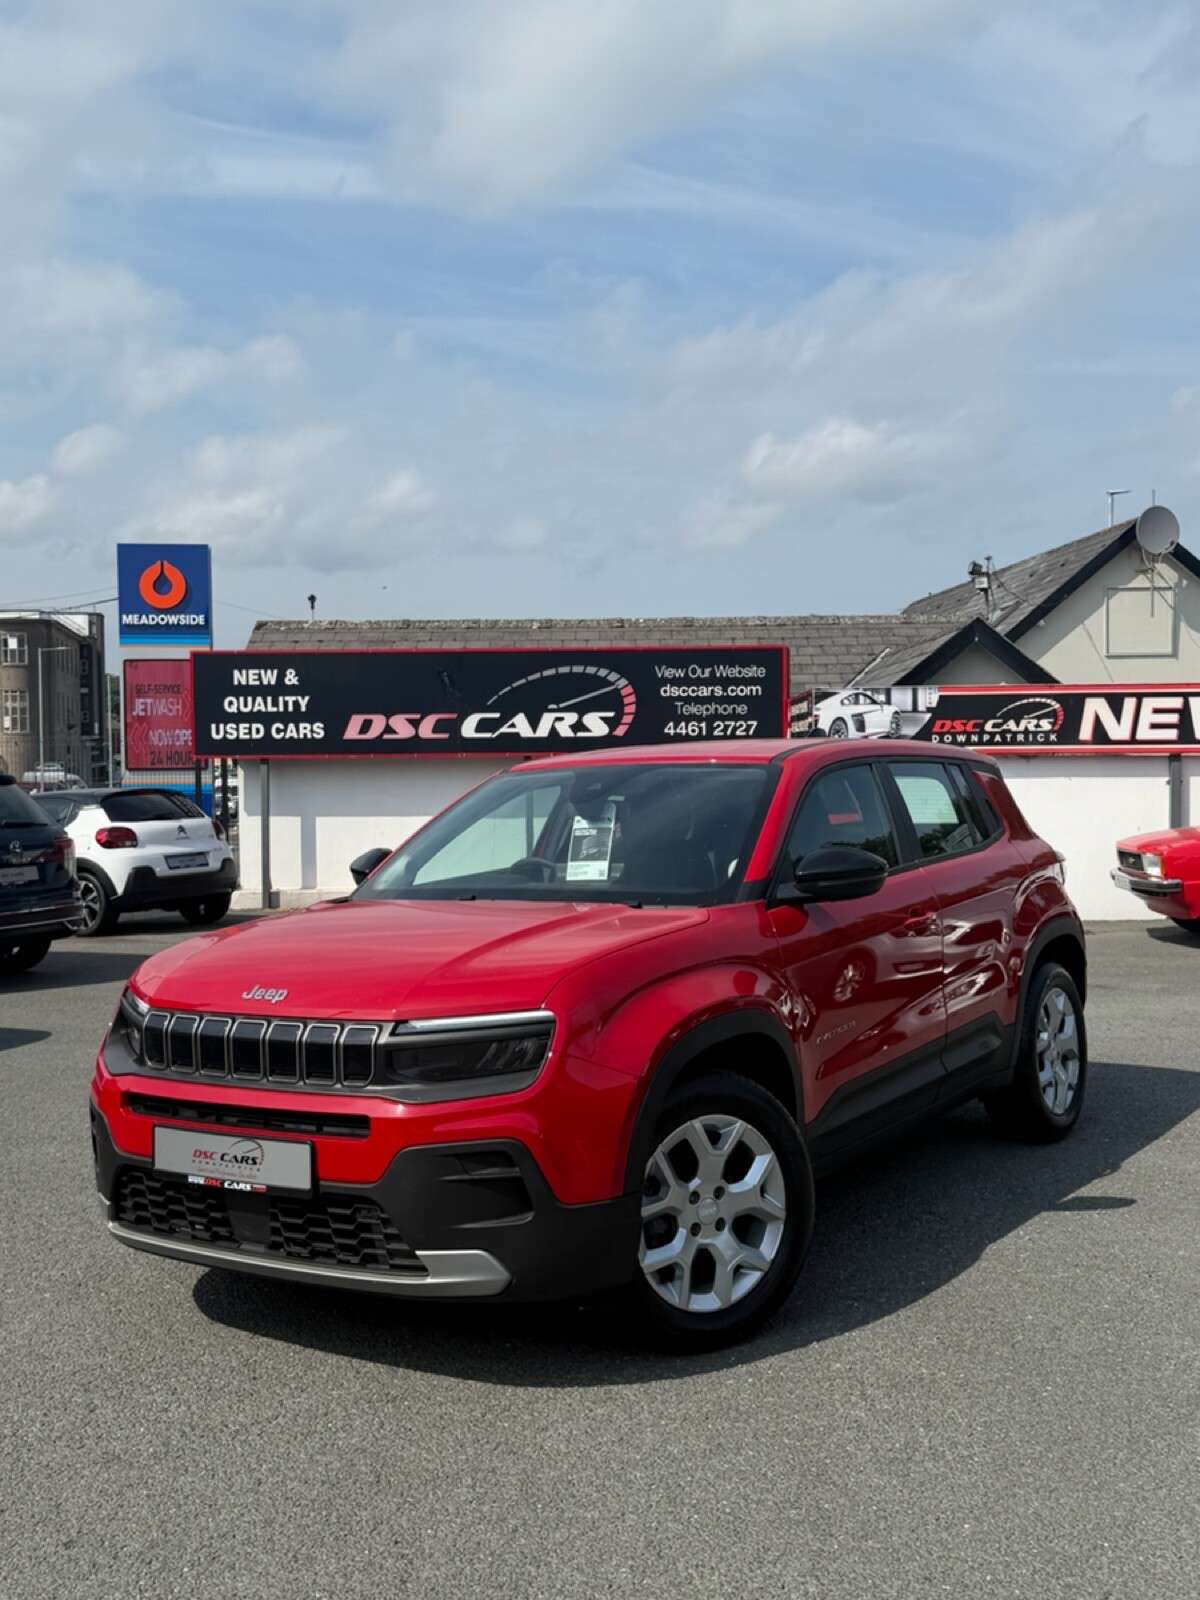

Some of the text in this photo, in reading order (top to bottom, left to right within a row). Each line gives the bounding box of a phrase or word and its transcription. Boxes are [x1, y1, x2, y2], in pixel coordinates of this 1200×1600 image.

[122, 614, 205, 625] MEADOWSIDE
[233, 668, 299, 685] NEW &
[655, 664, 766, 678] View Our Website
[135, 684, 182, 694] SELF-SERVICE
[660, 683, 762, 696] dsccars.com
[223, 696, 310, 713] QUALITY
[675, 702, 748, 717] Telephone
[211, 722, 325, 739] USED CARS
[343, 712, 615, 740] DSC CARS
[664, 720, 758, 736] 4461 2727
[932, 719, 1055, 732] DSC CARS
[931, 733, 1058, 743] DOWNPATRICK
[150, 751, 164, 766] 24
[241, 985, 288, 1004] Jeep
[193, 1149, 217, 1160] DSC
[220, 1152, 258, 1166] CARS
